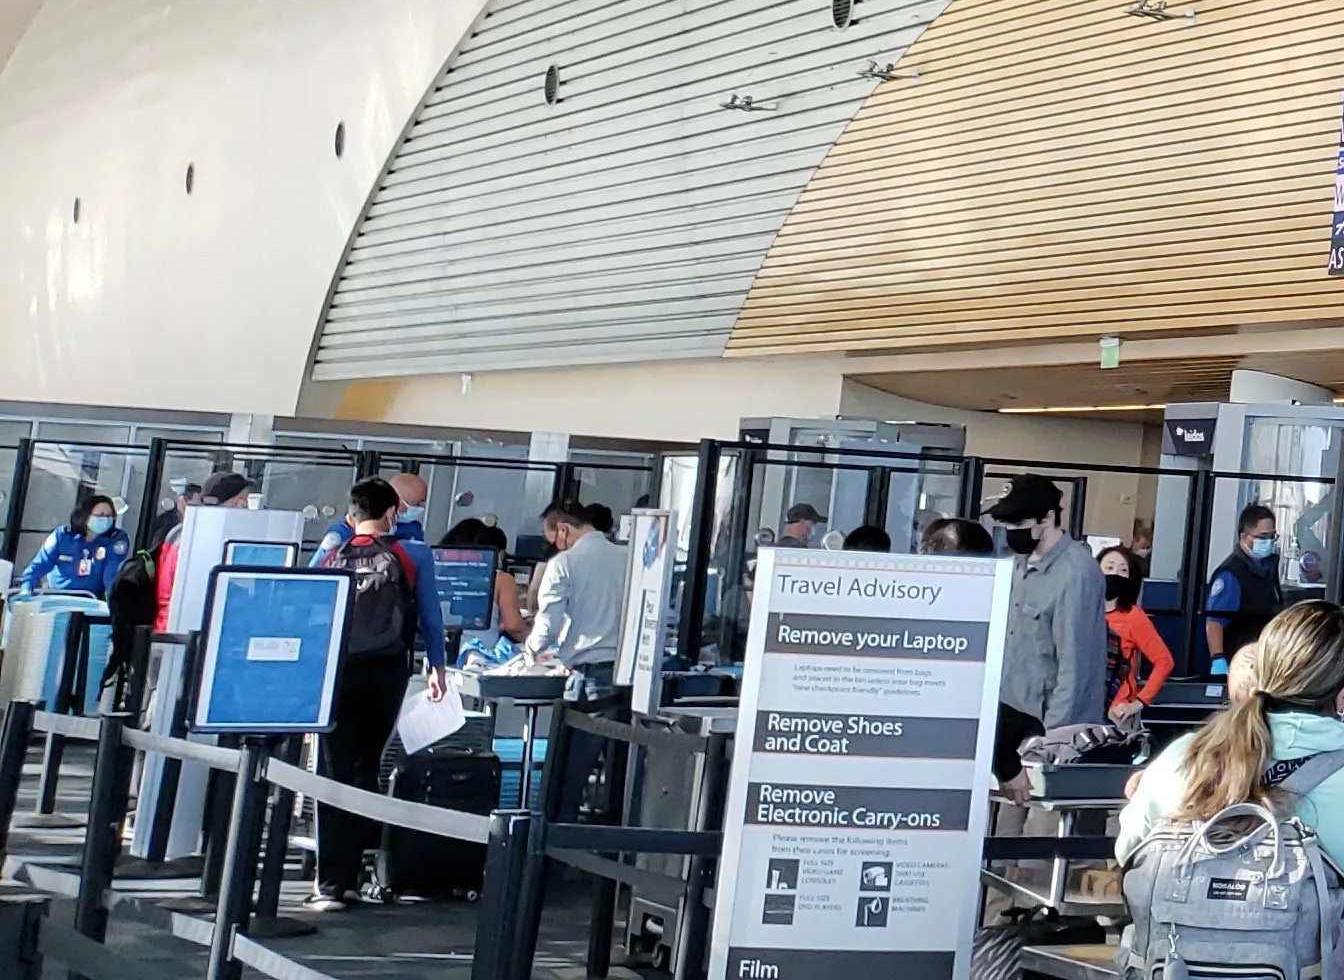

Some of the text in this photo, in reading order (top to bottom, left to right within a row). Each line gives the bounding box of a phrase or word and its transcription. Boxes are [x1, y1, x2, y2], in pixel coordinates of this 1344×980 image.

[1329, 249, 1344, 269] AS
[777, 574, 942, 605] Travel Advisory
[778, 625, 969, 653] Remove your Laptop
[768, 714, 903, 736] Remove Shoes
[765, 734, 849, 754] and Coat
[760, 785, 835, 804] Remove
[758, 804, 941, 829] Electronic Carry-ons
[739, 960, 779, 979] Film
